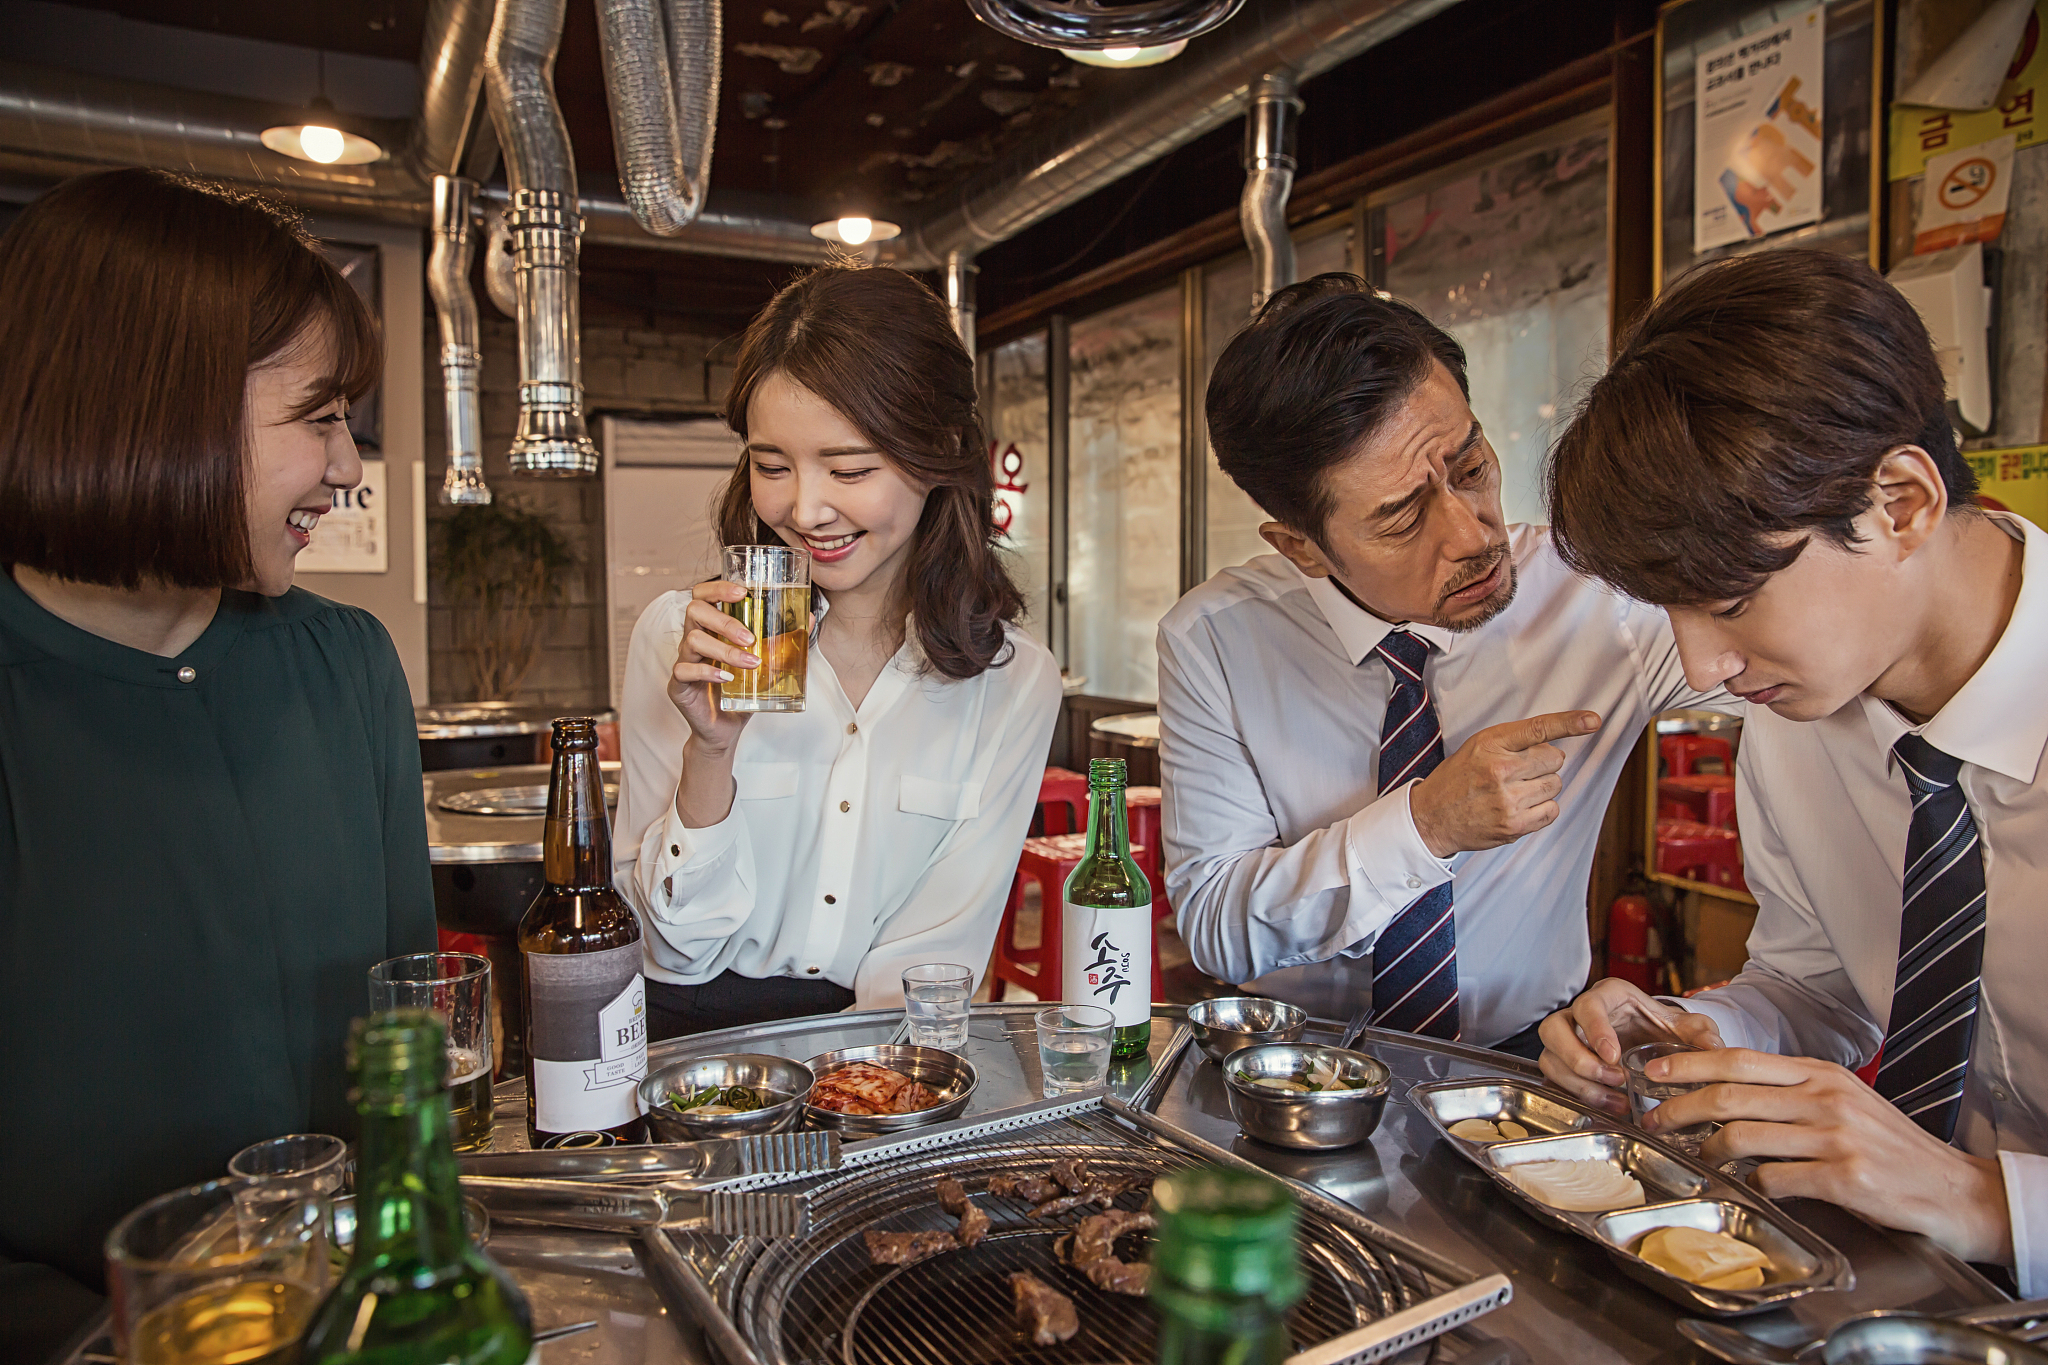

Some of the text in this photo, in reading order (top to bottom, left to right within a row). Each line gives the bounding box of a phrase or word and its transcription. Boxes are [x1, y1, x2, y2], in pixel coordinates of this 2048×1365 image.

[1083, 931, 1131, 1005] 소주
[1121, 952, 1130, 973] SOJU
[616, 1017, 645, 1047] BEE
[606, 1068, 625, 1077] TASTE
[607, 1062, 625, 1071] GOOD
